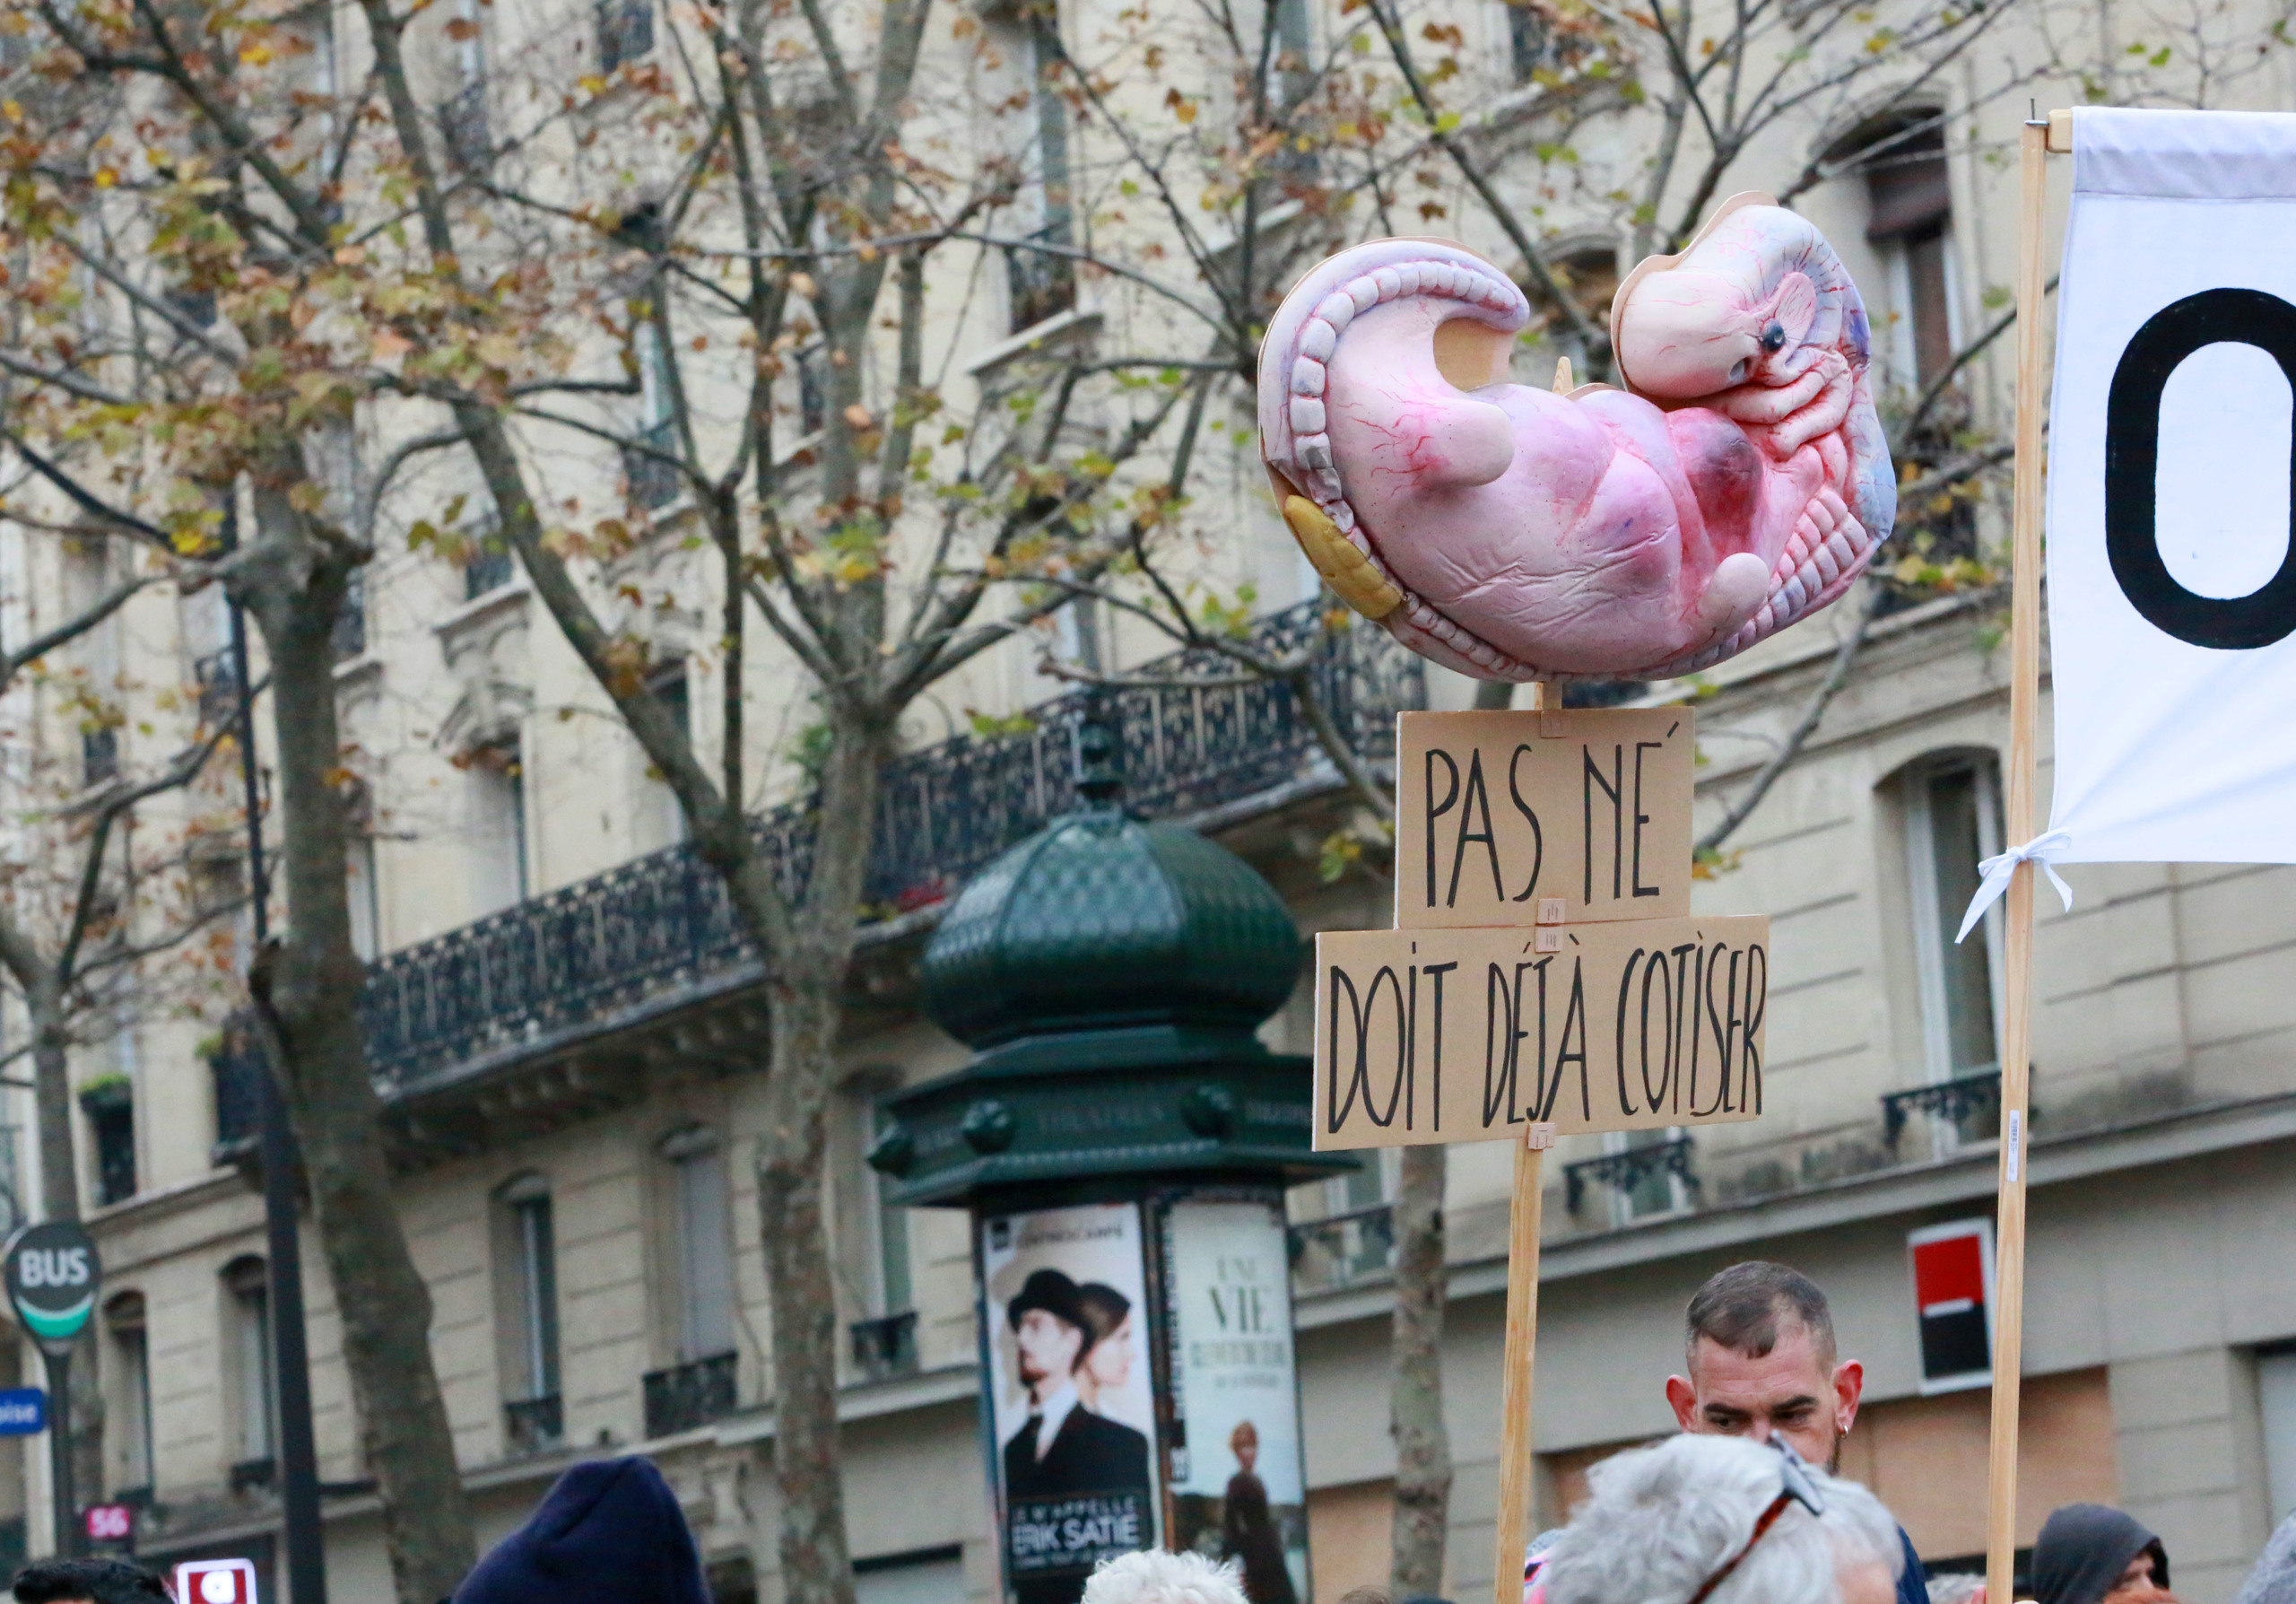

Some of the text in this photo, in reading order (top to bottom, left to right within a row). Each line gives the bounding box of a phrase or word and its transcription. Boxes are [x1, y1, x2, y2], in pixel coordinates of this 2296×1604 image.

[1425, 720, 1680, 908] PAS NÉ
[1482, 933, 1591, 1129] DÉJÀ
[20, 1246, 90, 1287] BUS
